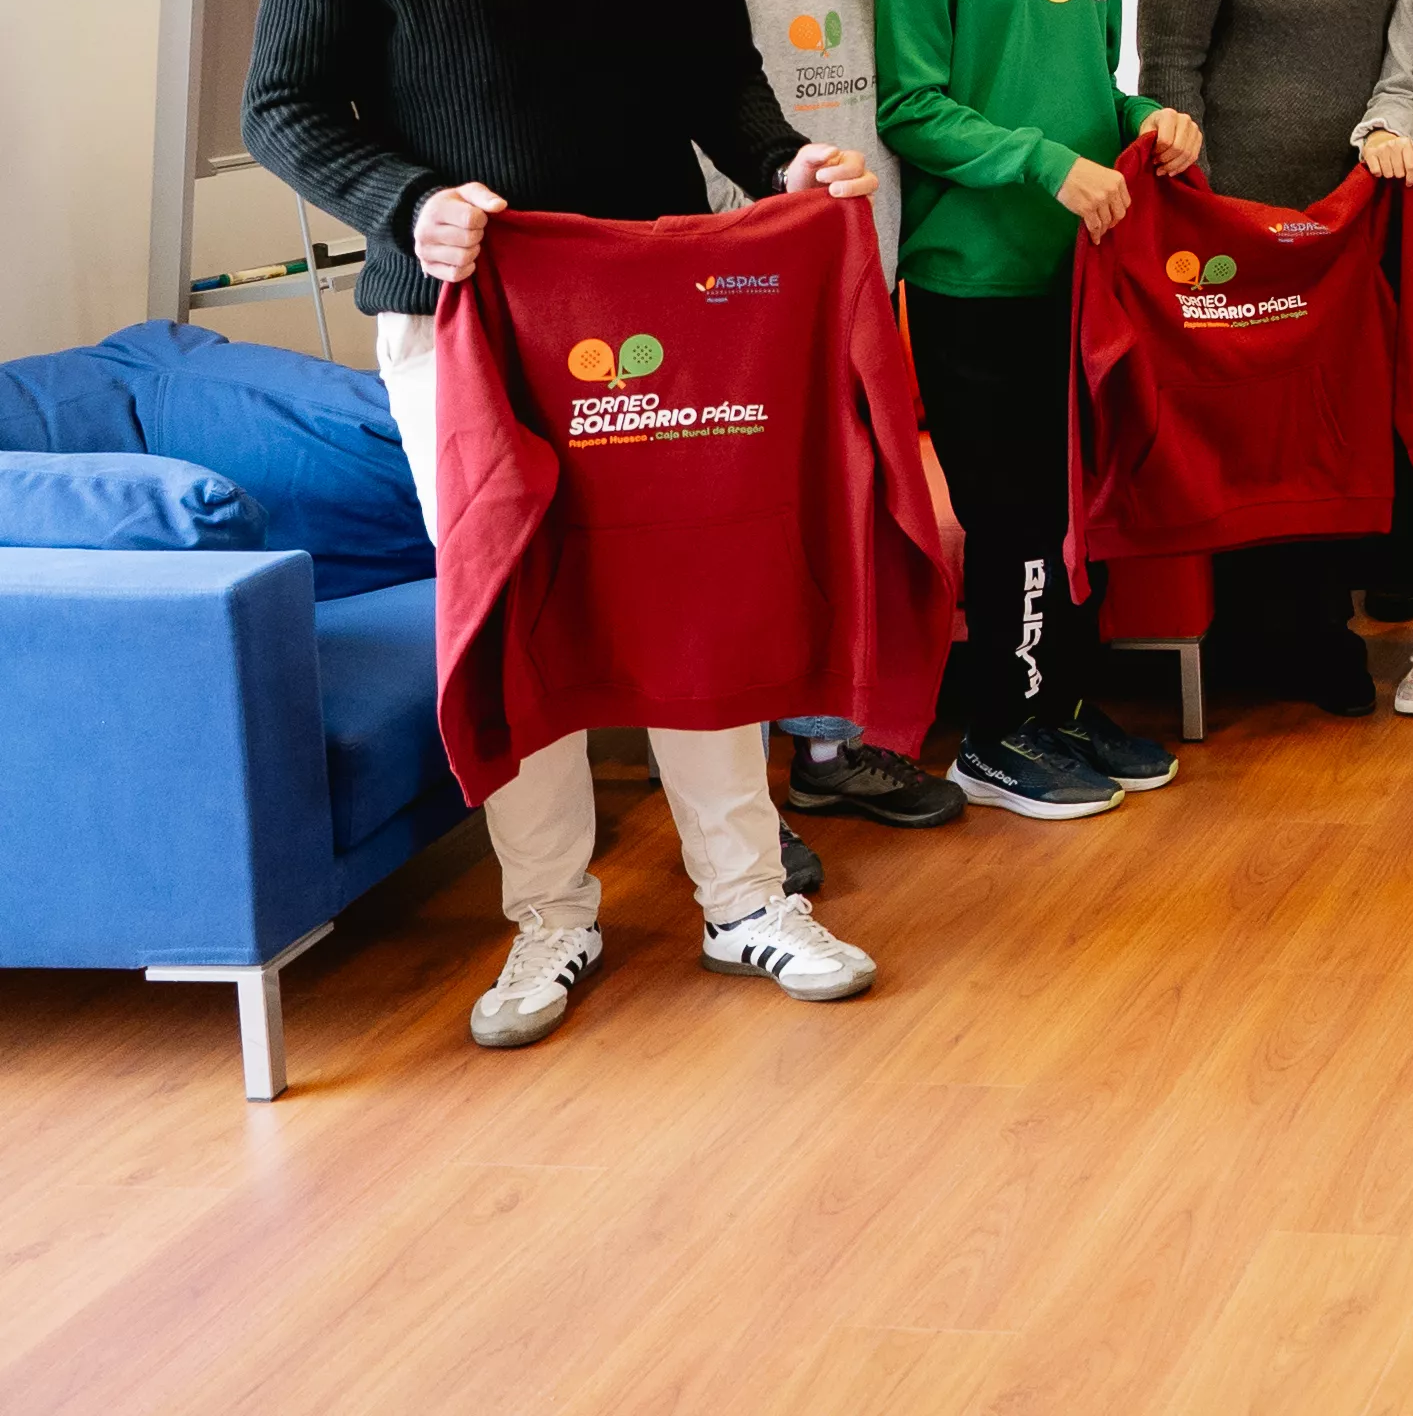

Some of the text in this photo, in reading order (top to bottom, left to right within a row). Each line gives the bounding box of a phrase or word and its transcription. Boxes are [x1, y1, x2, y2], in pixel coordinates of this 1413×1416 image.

[796, 64, 845, 81] TORNEO
[796, 77, 868, 99] SOLIDARIO
[715, 274, 780, 289] ASPACE
[1175, 293, 1227, 308] TORNEO
[1182, 295, 1308, 319] SOLIDARIO PÁDEL
[572, 393, 660, 417] TORNEO
[569, 400, 769, 436] SOLIDARIO PÁDEL
[568, 425, 765, 449] Aspace Huesca Caja Rural de Aragón
